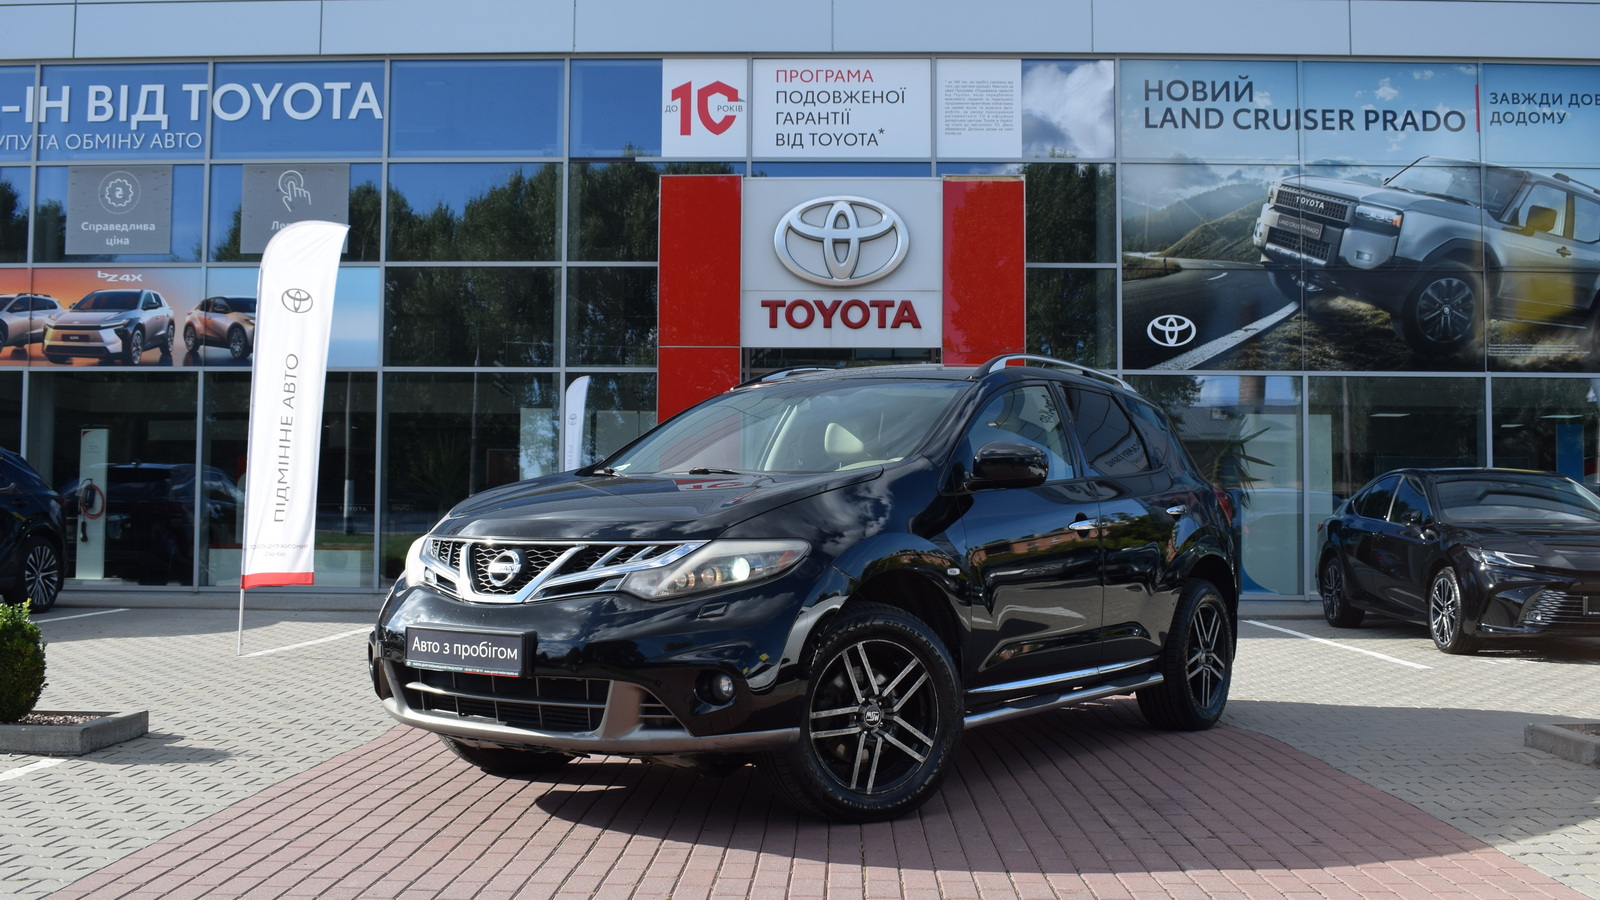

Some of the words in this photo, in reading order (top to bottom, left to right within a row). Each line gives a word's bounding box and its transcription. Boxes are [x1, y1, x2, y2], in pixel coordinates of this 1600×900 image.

[775, 69, 874, 83] ПРОГРАМА
[775, 87, 906, 107] ПОДОВЖЕНОЇ
[1144, 74, 1254, 103] НОВИЙ
[87, 84, 169, 131] ВІД
[182, 81, 384, 121] TOYOTA
[1489, 92, 1563, 108] ЗАВЖДИ
[665, 105, 678, 113] ДО
[717, 105, 743, 113] РОКІВ
[775, 109, 851, 126] ГАРАНТІЇ
[1144, 107, 1224, 130] LAND
[1232, 108, 1356, 132] CRUISER
[1364, 109, 1467, 133] PRADO
[1490, 111, 1567, 127] ДОДОМУ
[38, 134, 59, 150] ТА
[65, 133, 147, 150] ОБМІНУ
[150, 132, 202, 149] АВТО
[775, 133, 804, 149] ВІД
[1296, 196, 1325, 209] TOYOTA
[81, 221, 156, 233] Справедлива
[105, 236, 130, 247] ціна
[761, 299, 922, 330] TOYOTA
[282, 353, 299, 410] АВТО
[273, 415, 294, 523] ПІДМІННЕ
[411, 636, 440, 654] Авто
[442, 642, 450, 655] з
[453, 641, 518, 660] пробігом
